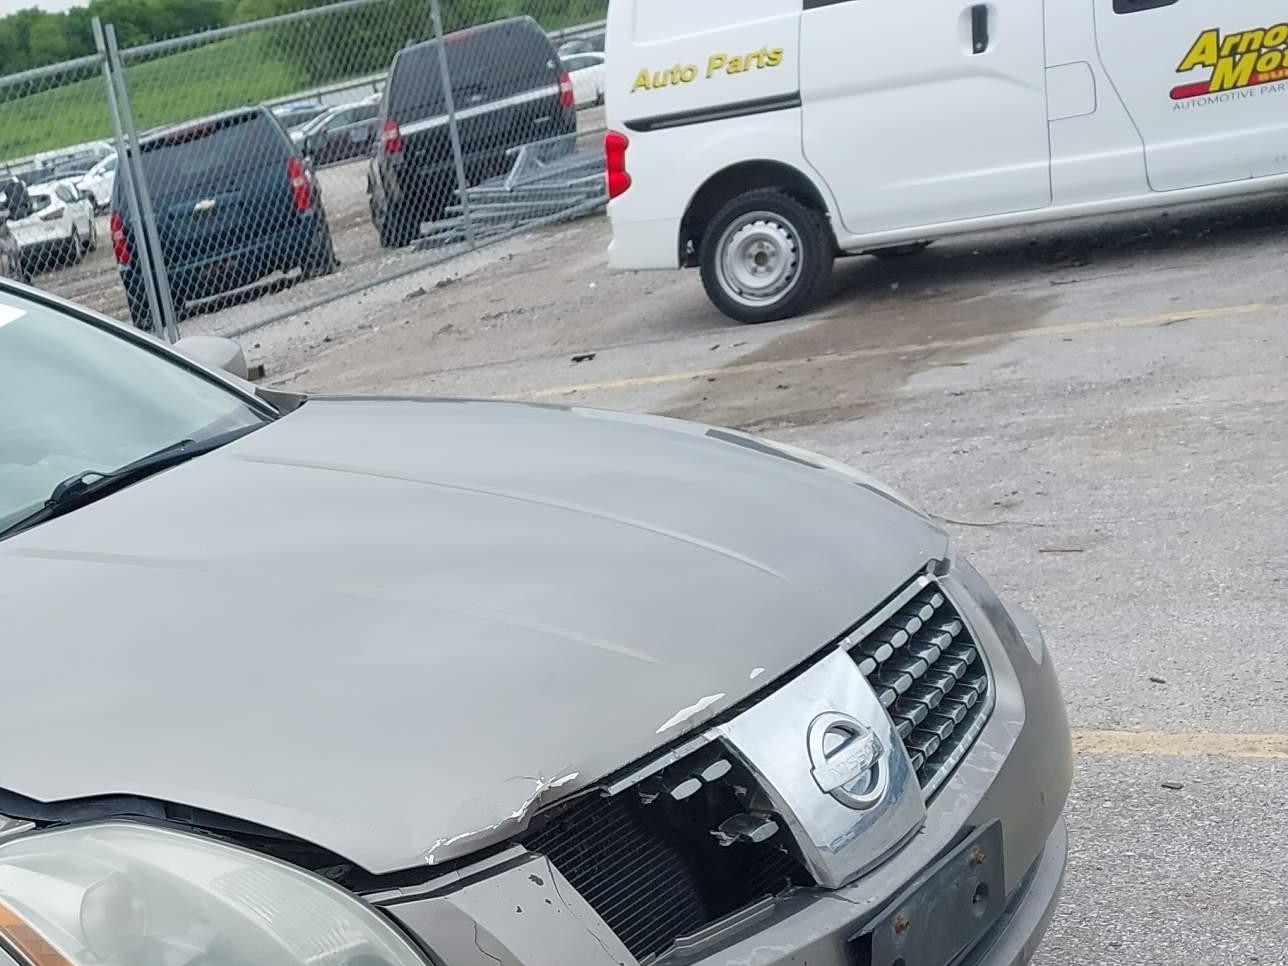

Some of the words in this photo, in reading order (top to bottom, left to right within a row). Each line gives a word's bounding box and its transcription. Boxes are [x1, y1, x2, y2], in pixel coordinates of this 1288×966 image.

[630, 63, 698, 93] Auto
[705, 45, 785, 79] Parts
[1172, 88, 1257, 111] AUTOMOTIVE
